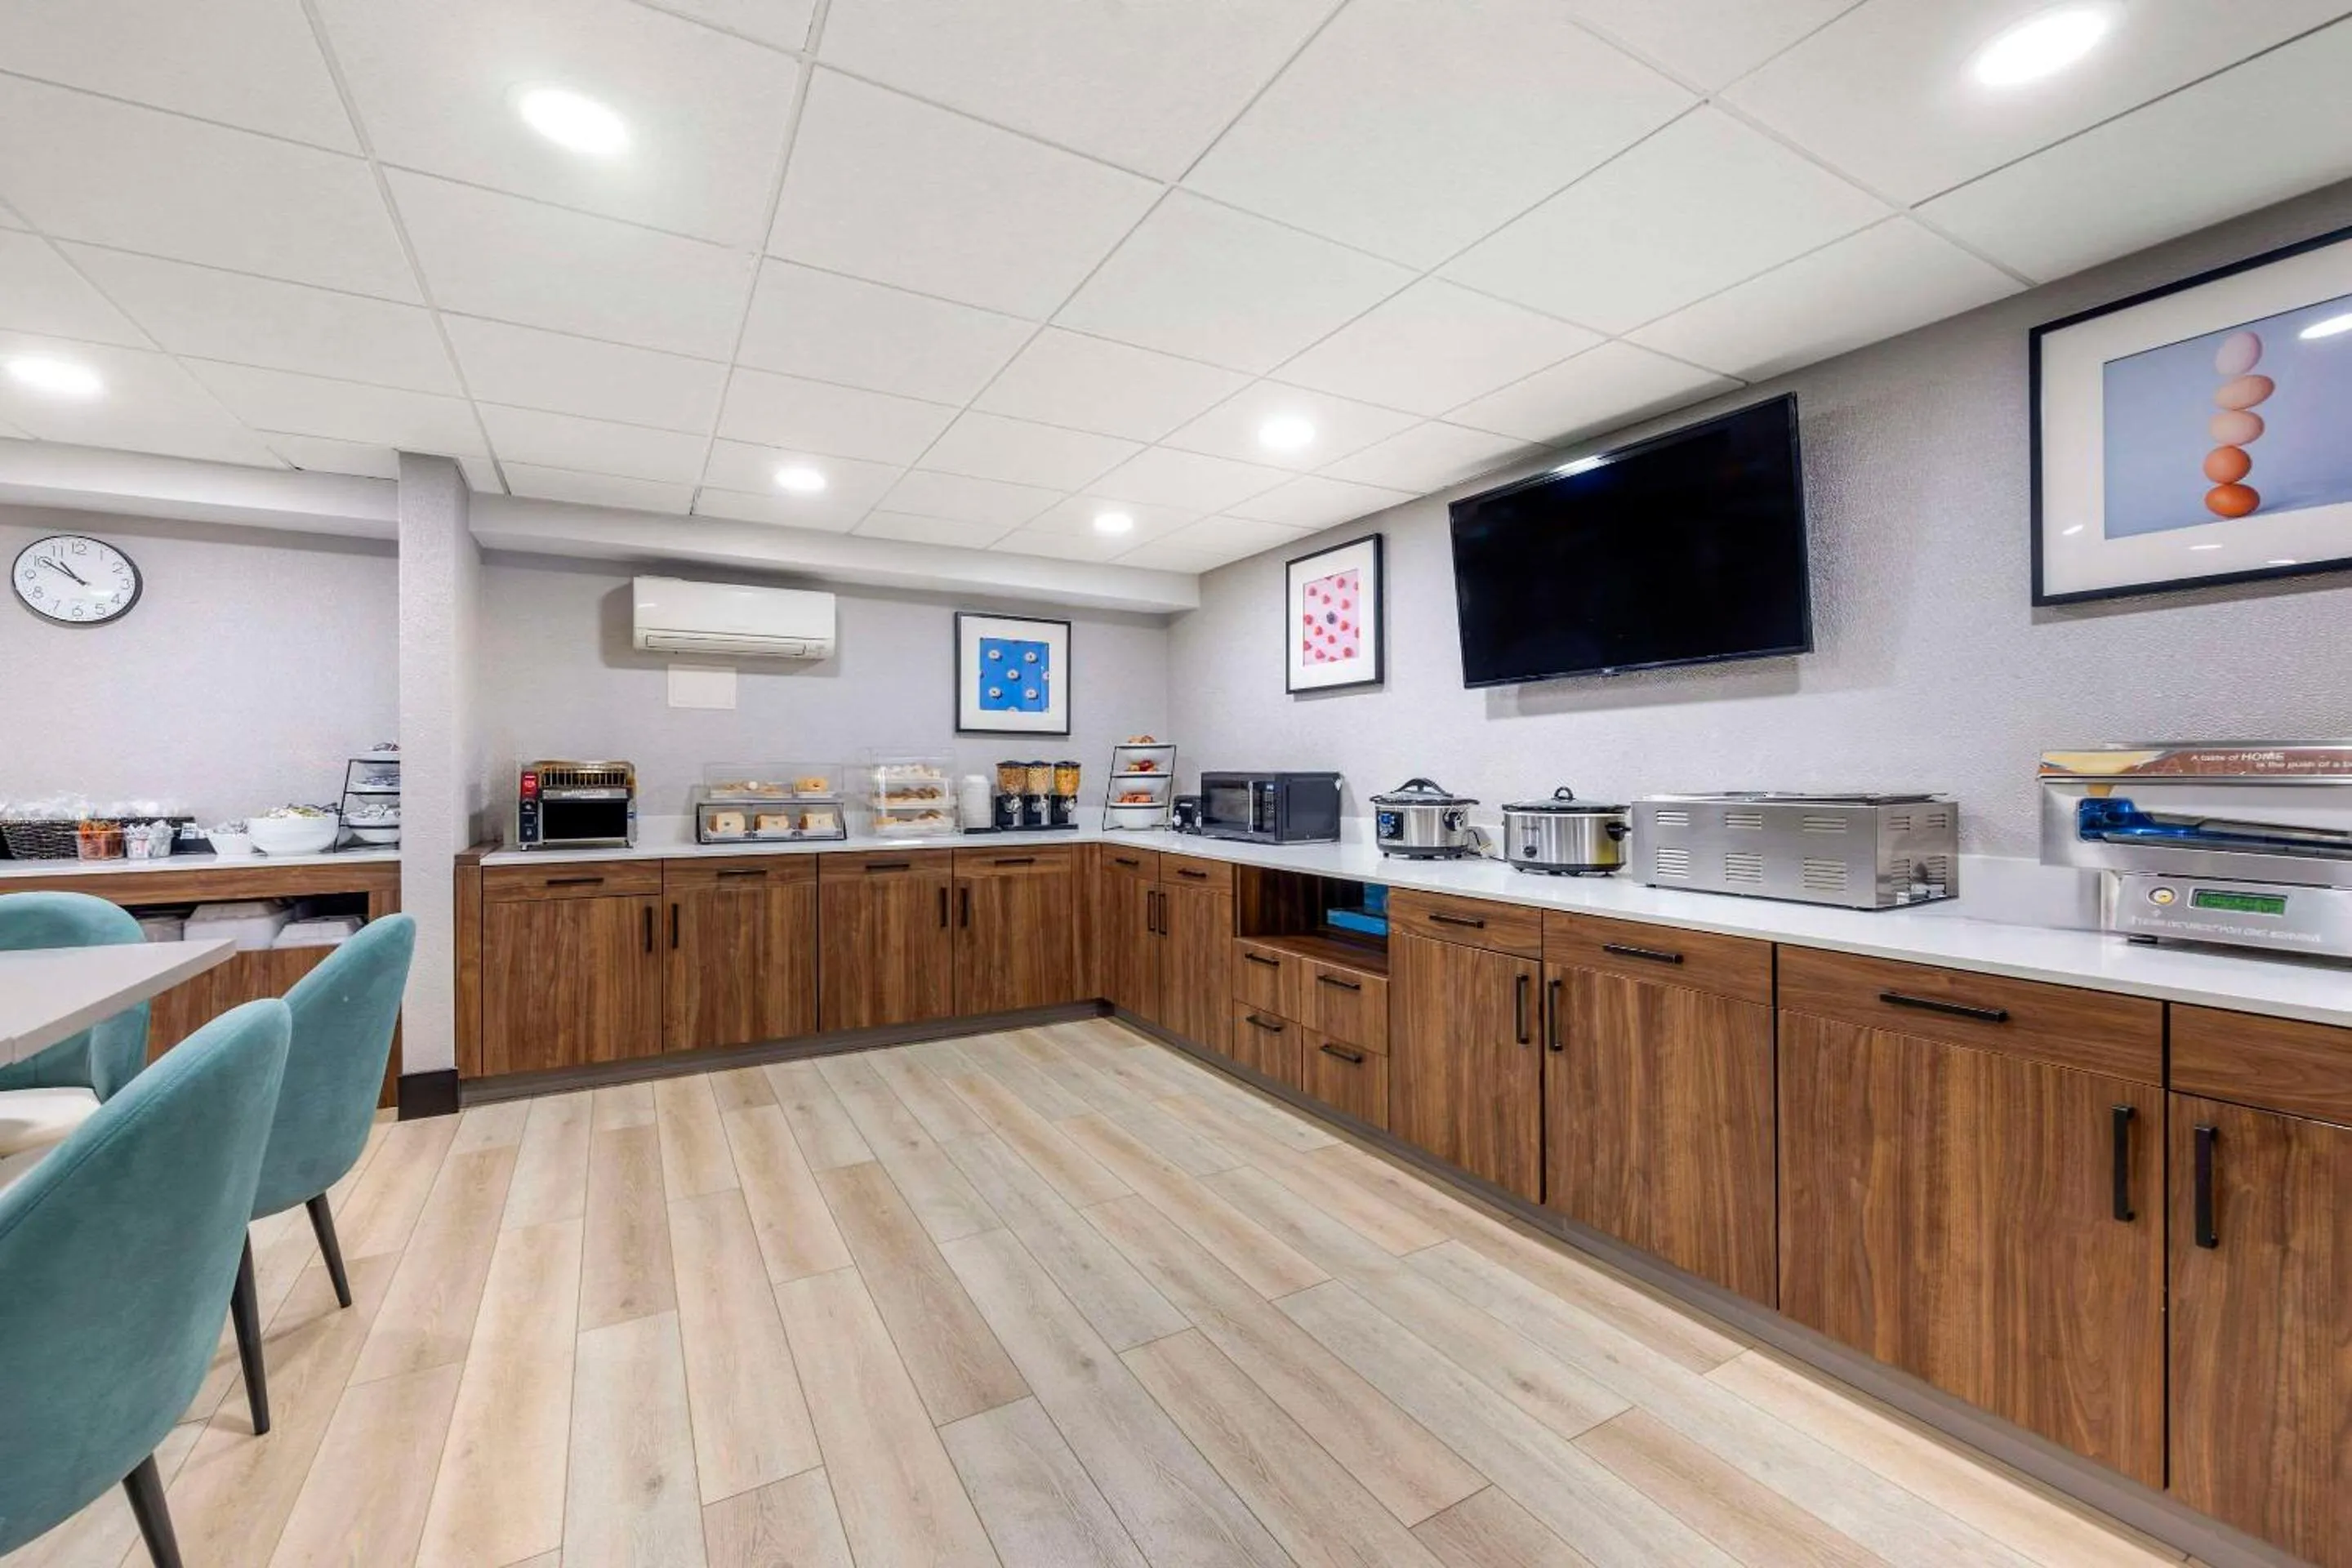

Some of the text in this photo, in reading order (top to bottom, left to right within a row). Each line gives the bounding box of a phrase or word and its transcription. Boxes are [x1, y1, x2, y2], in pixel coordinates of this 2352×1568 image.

[52, 545, 64, 558] 11
[71, 542, 87, 555] 12
[33, 555, 53, 568] 10
[99, 550, 104, 561] 1
[24, 569, 37, 580] 9
[112, 562, 123, 575] 2
[120, 578, 130, 590] 3
[33, 586, 43, 599] 8
[110, 594, 121, 604] 4
[53, 599, 61, 611] 7
[71, 604, 83, 617] 6
[95, 603, 106, 616] 5
[2241, 752, 2285, 761] HOME
